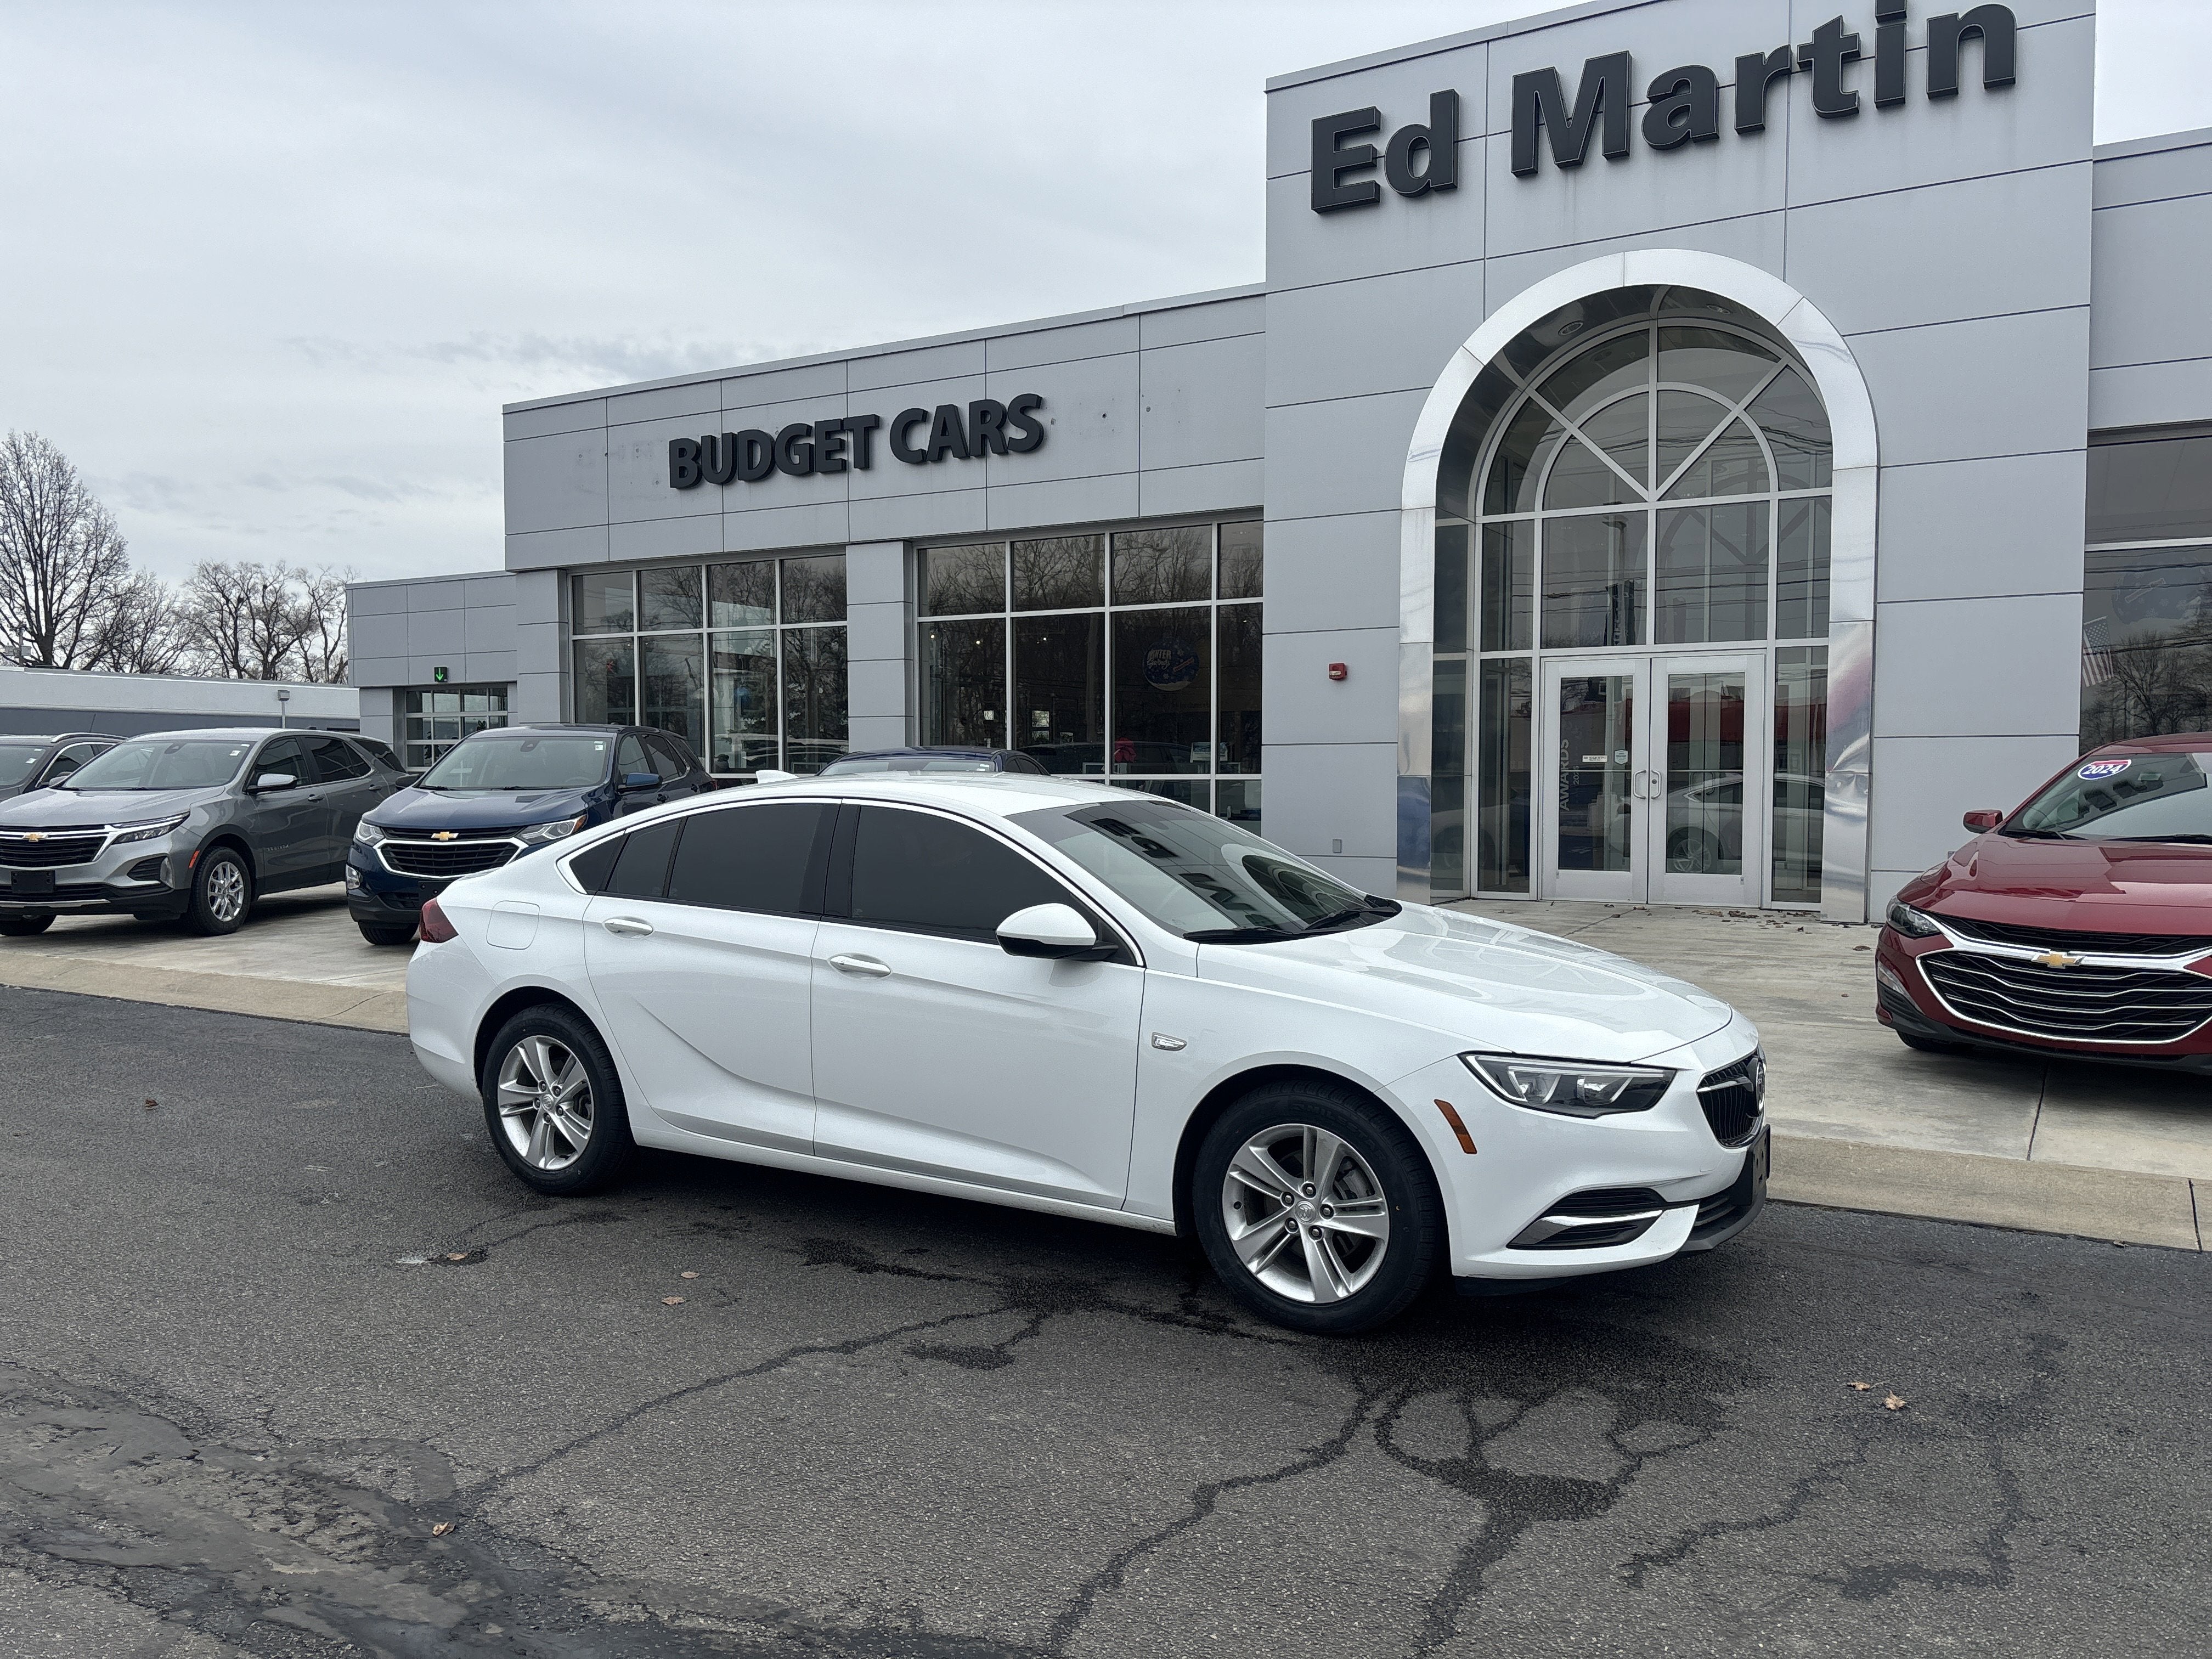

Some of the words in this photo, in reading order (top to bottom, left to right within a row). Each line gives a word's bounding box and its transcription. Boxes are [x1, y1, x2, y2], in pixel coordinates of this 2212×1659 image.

[1311, 88, 1459, 213] Ed
[1510, 0, 2017, 176] Martin
[669, 414, 881, 489] BUDGET
[889, 393, 1045, 465] CARS
[1560, 739, 1569, 811] AWARDS
[2081, 764, 2124, 775] 2024
